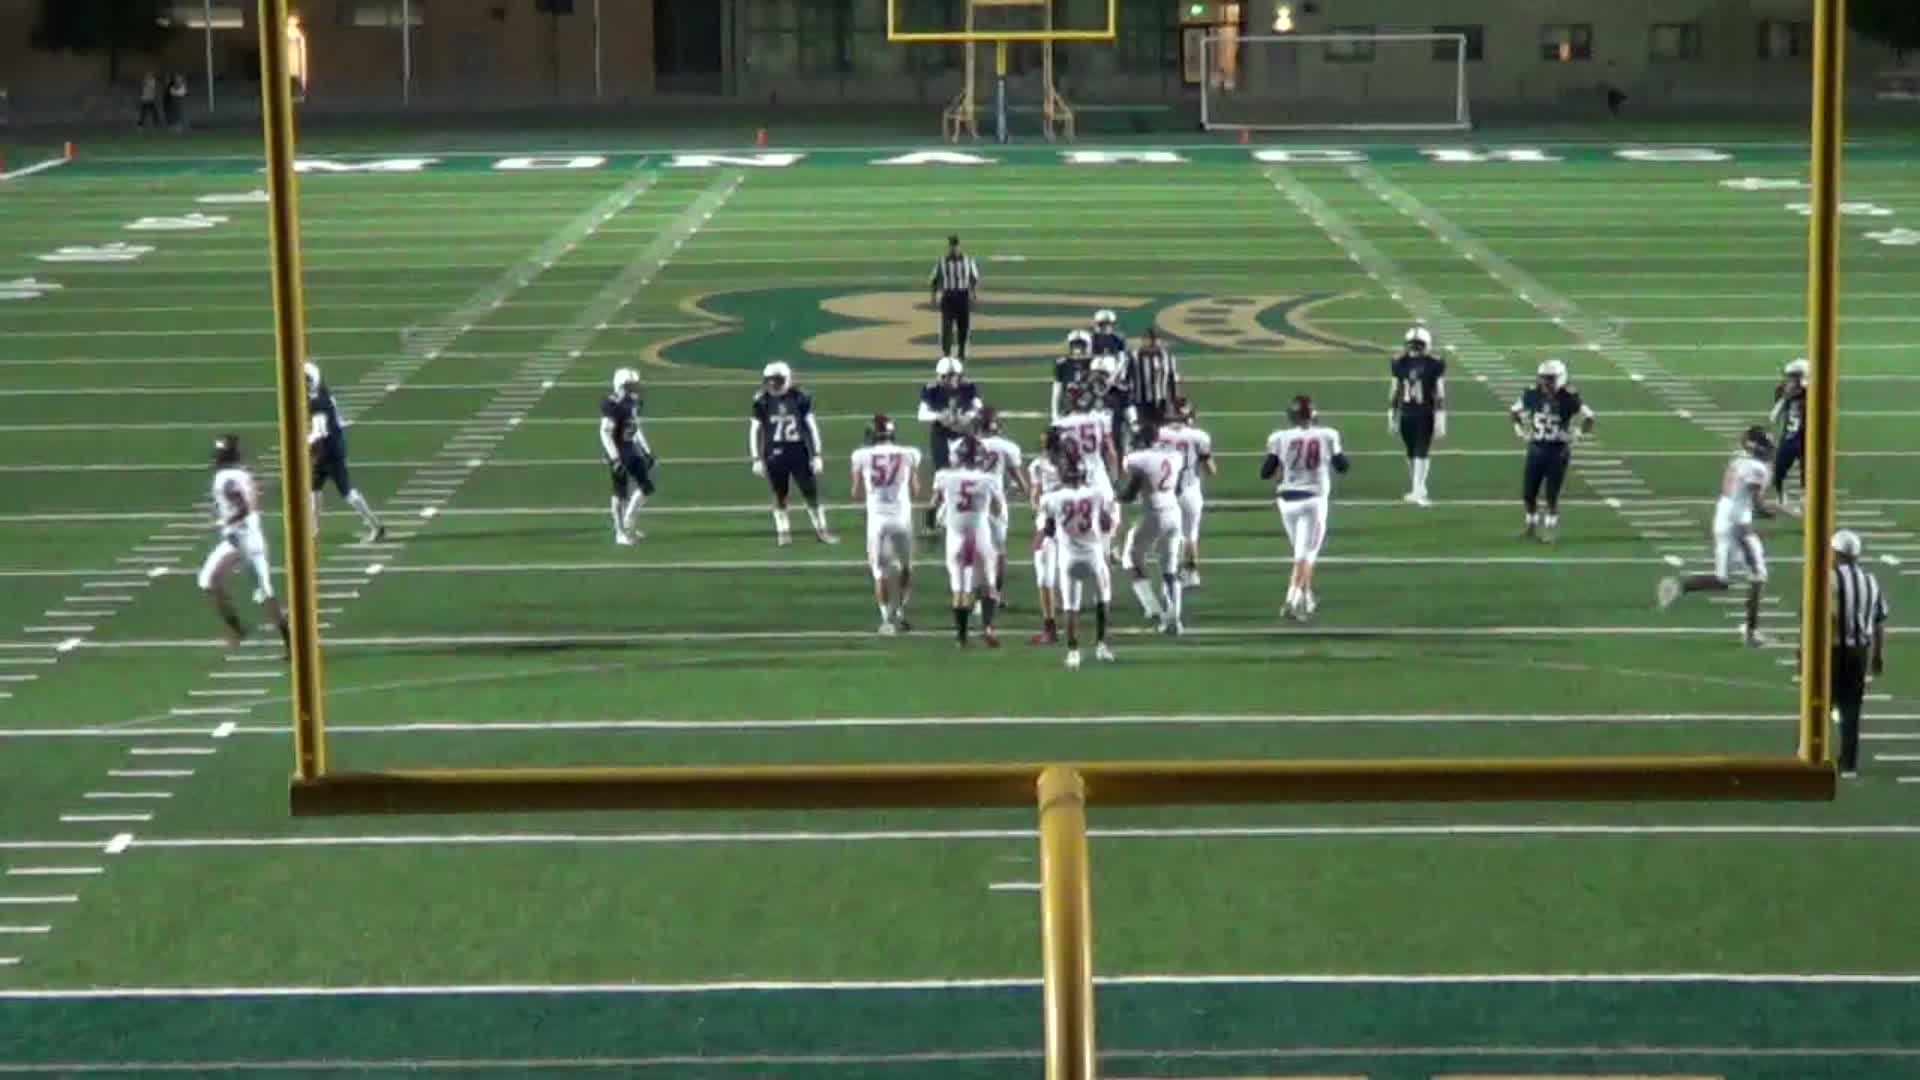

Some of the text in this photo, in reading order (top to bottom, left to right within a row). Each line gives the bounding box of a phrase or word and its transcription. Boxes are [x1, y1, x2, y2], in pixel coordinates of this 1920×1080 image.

[769, 413, 800, 442] 72
[1533, 411, 1561, 441] 55
[871, 453, 903, 488] 57
[1158, 457, 1173, 492] 2
[957, 480, 976, 513] 5
